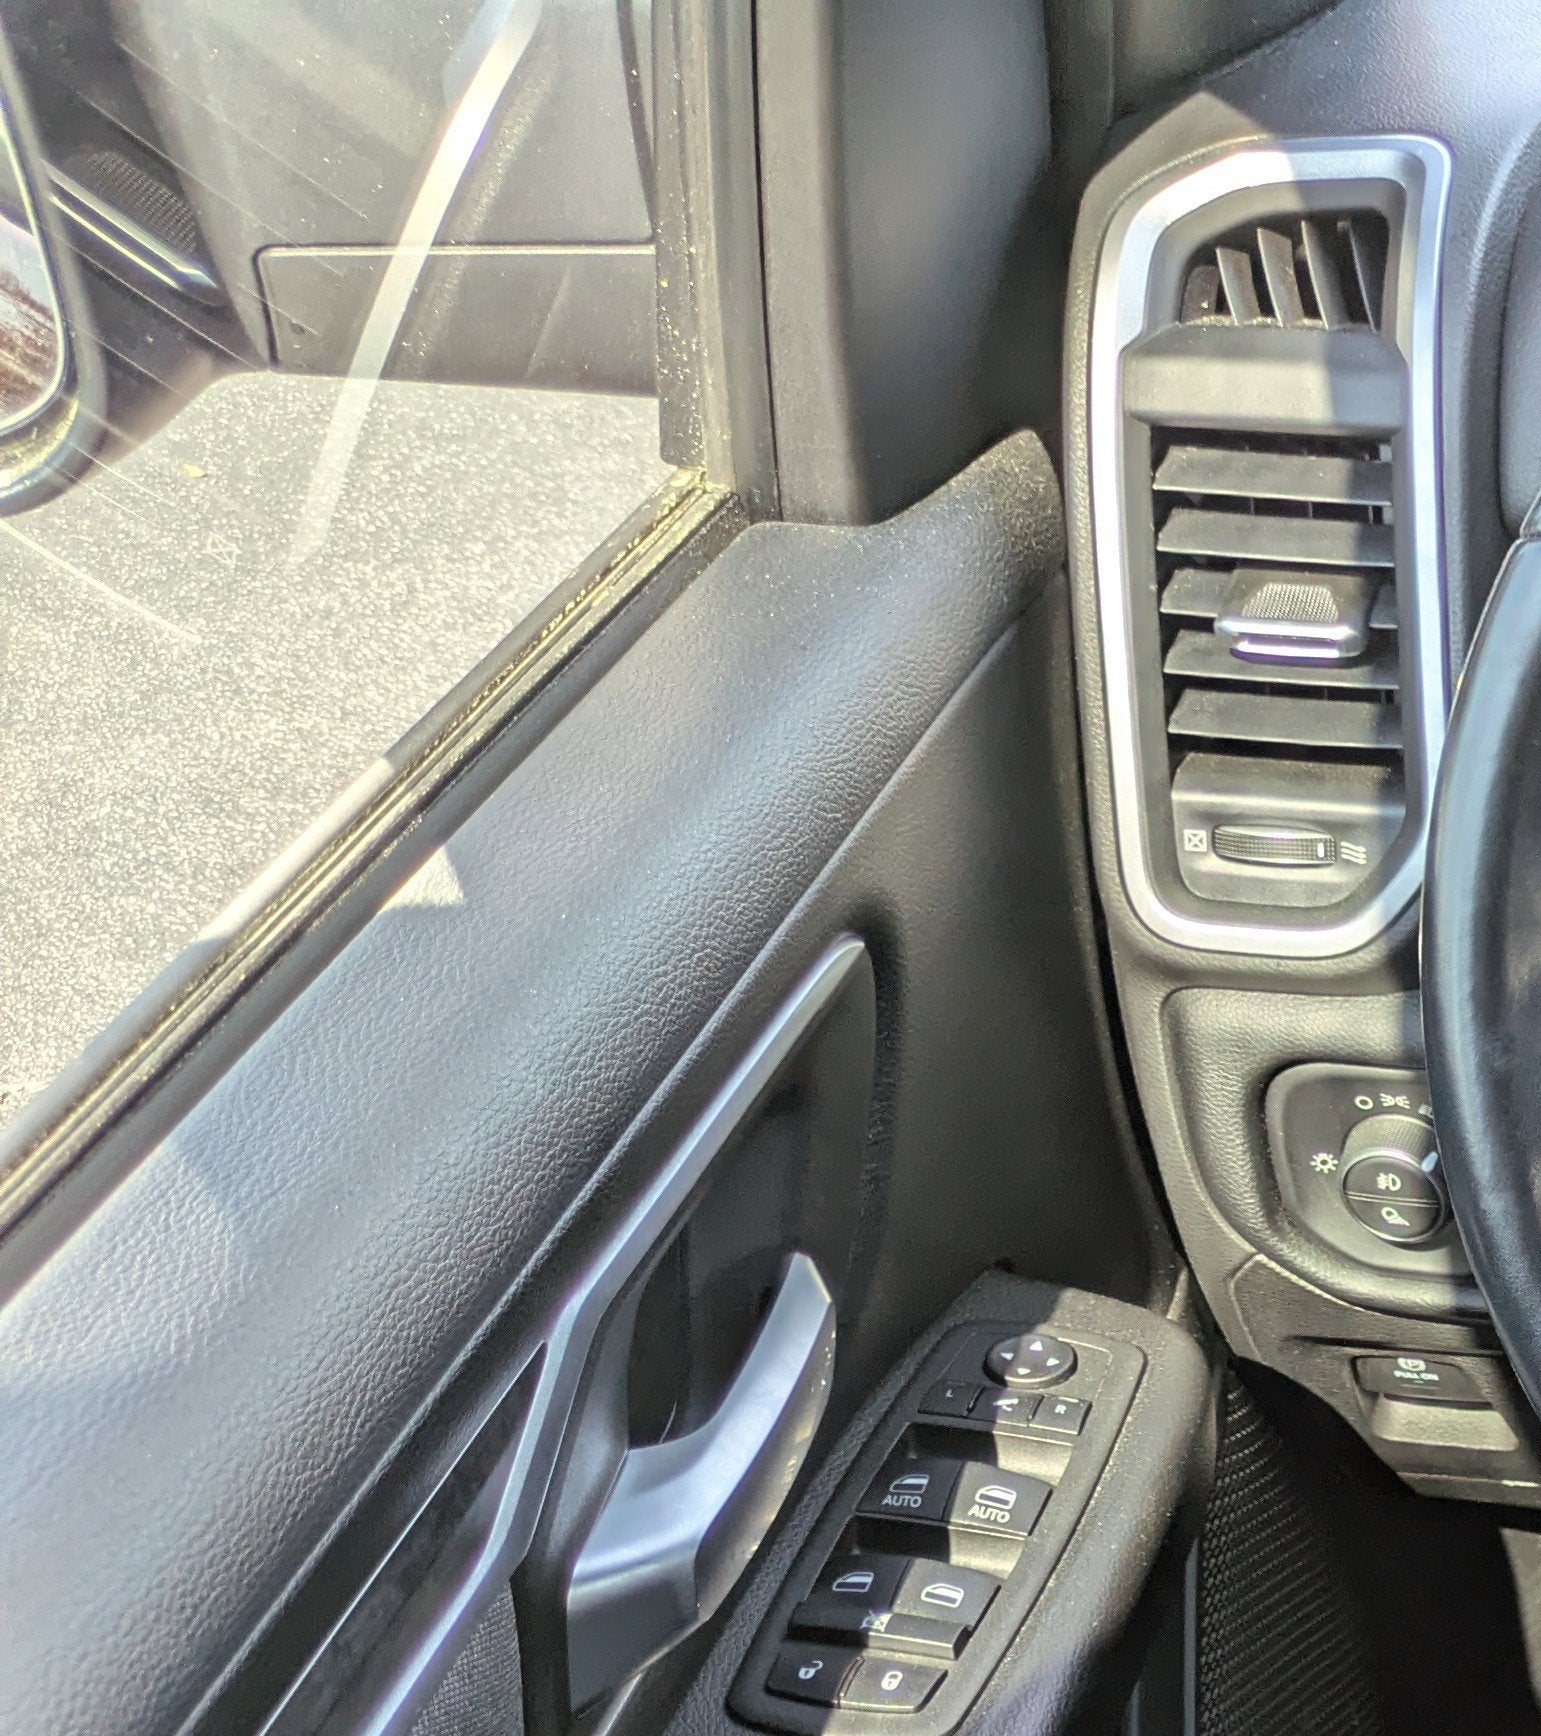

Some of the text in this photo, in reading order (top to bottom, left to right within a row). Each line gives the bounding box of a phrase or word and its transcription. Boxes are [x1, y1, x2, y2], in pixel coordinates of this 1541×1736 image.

[1054, 1404, 1067, 1415] R
[882, 1494, 922, 1509] AUTO
[968, 1504, 1011, 1524] AUTO
